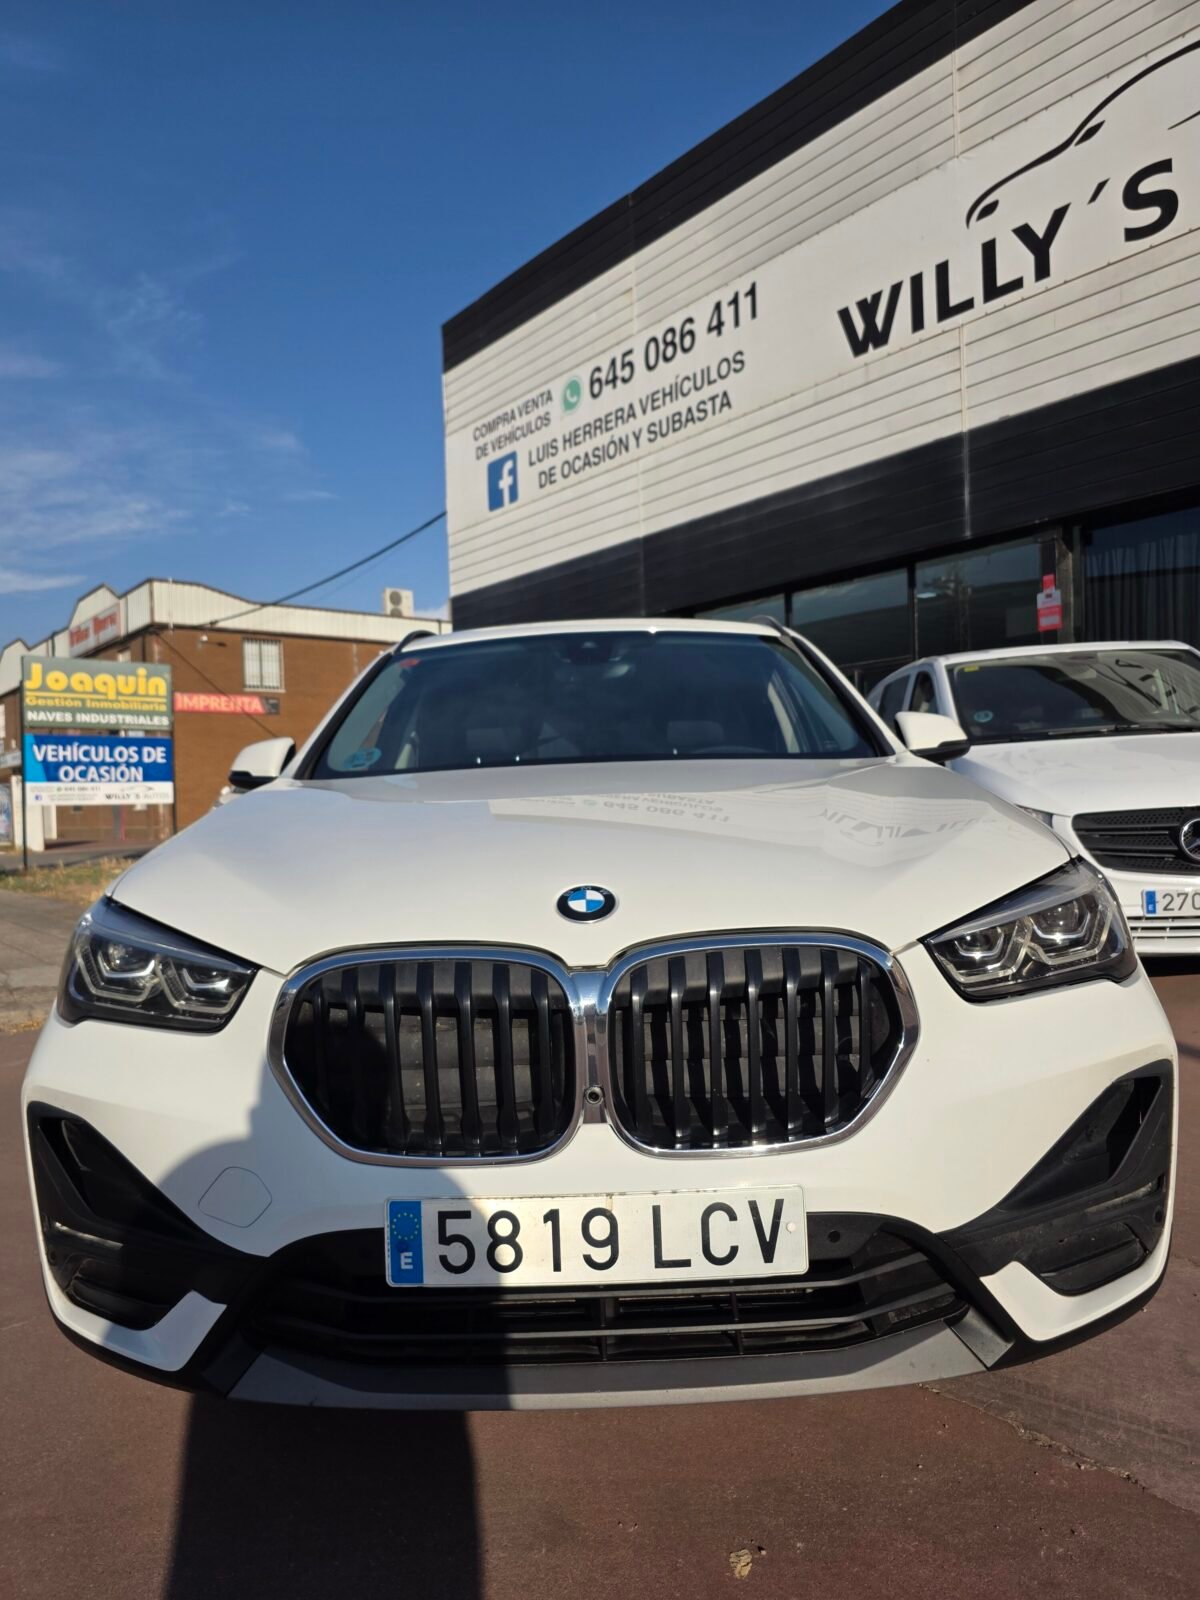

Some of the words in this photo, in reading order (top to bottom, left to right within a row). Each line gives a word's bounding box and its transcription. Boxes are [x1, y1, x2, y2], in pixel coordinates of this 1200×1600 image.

[589, 348, 635, 399] 645
[645, 317, 695, 371] 086
[707, 281, 757, 337] 411
[473, 408, 516, 441] COMPRA
[517, 389, 553, 418] VENTA
[528, 438, 559, 467] LUIS
[562, 402, 636, 451] HERRERA
[639, 350, 745, 416] VEHÍCULOS
[538, 466, 557, 489] DE
[561, 433, 630, 479] OCASIÓN
[632, 427, 642, 449] Y
[647, 390, 732, 443] SUBASTA
[476, 442, 490, 460] DE
[25, 662, 167, 700] Joaquin
[177, 692, 264, 713] IMPRENTA
[27, 710, 73, 722] NAVES
[76, 712, 169, 726] INDUSTRIALES
[33, 742, 139, 763] VEHÍCULOS
[142, 746, 167, 763] DE
[58, 763, 143, 782] OCASIÓN
[1162, 892, 1200, 911] 270
[437, 1207, 619, 1275] 5819
[651, 1198, 785, 1269] LCV
[401, 1252, 414, 1270] E
